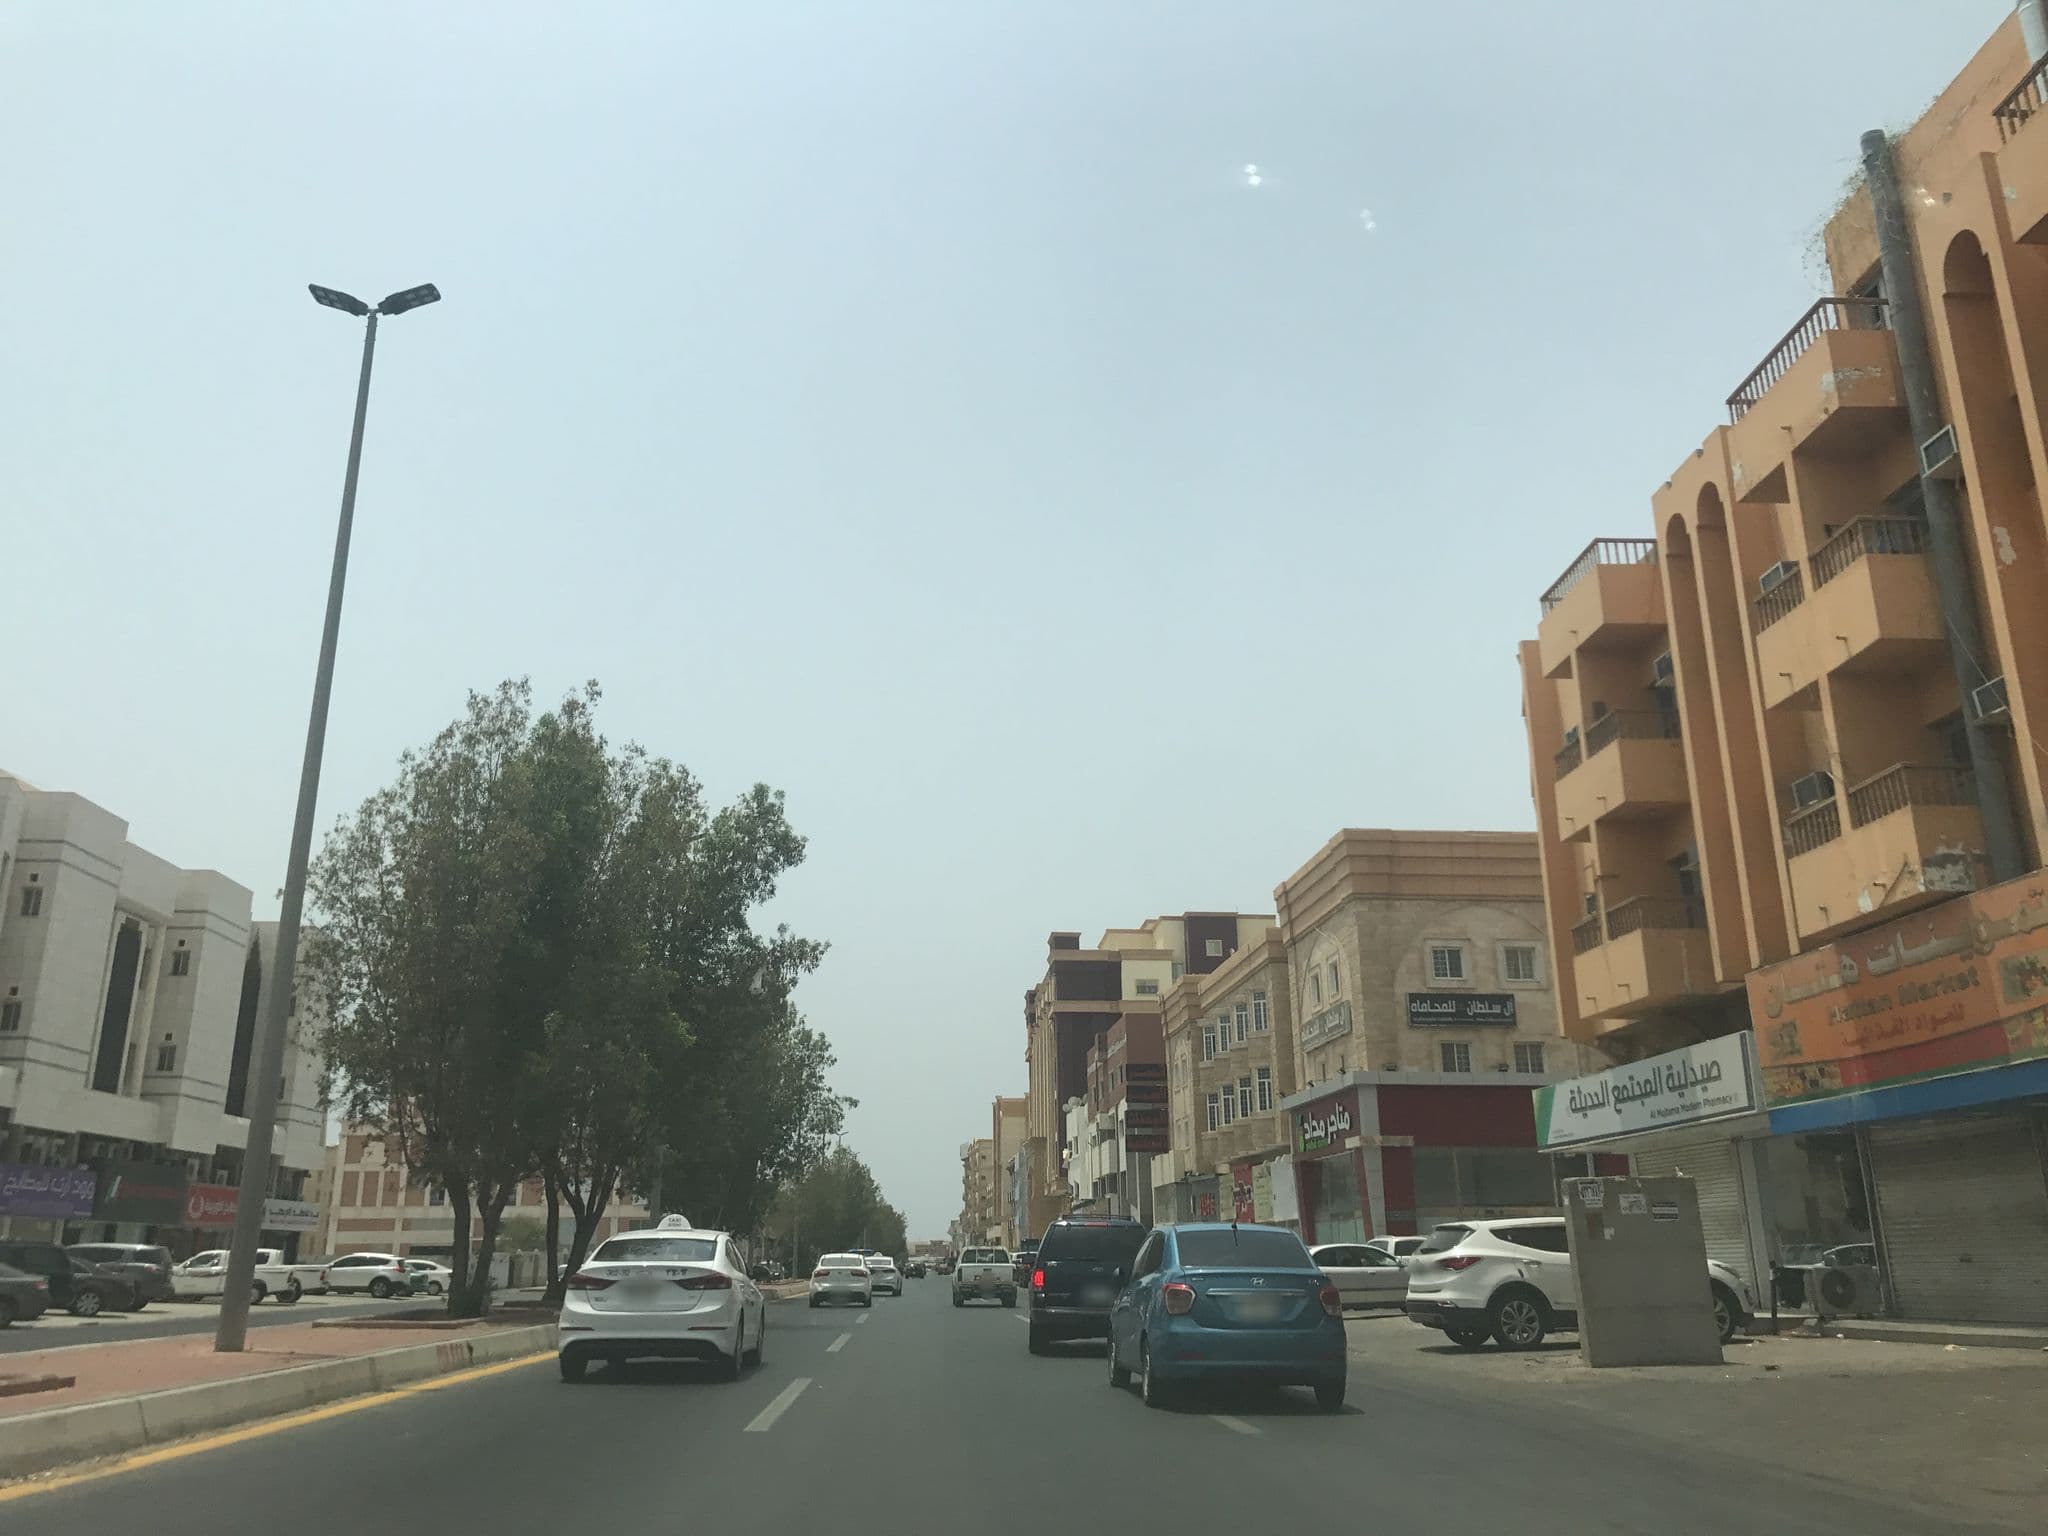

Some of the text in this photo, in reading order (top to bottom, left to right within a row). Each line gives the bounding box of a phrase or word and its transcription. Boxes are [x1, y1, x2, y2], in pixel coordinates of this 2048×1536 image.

[1466, 999, 1502, 1016] سلطان
[1569, 1058, 1722, 1119] صيدلية المجتمع الحديثة
[1303, 1101, 1351, 1145] متاجر مداد
